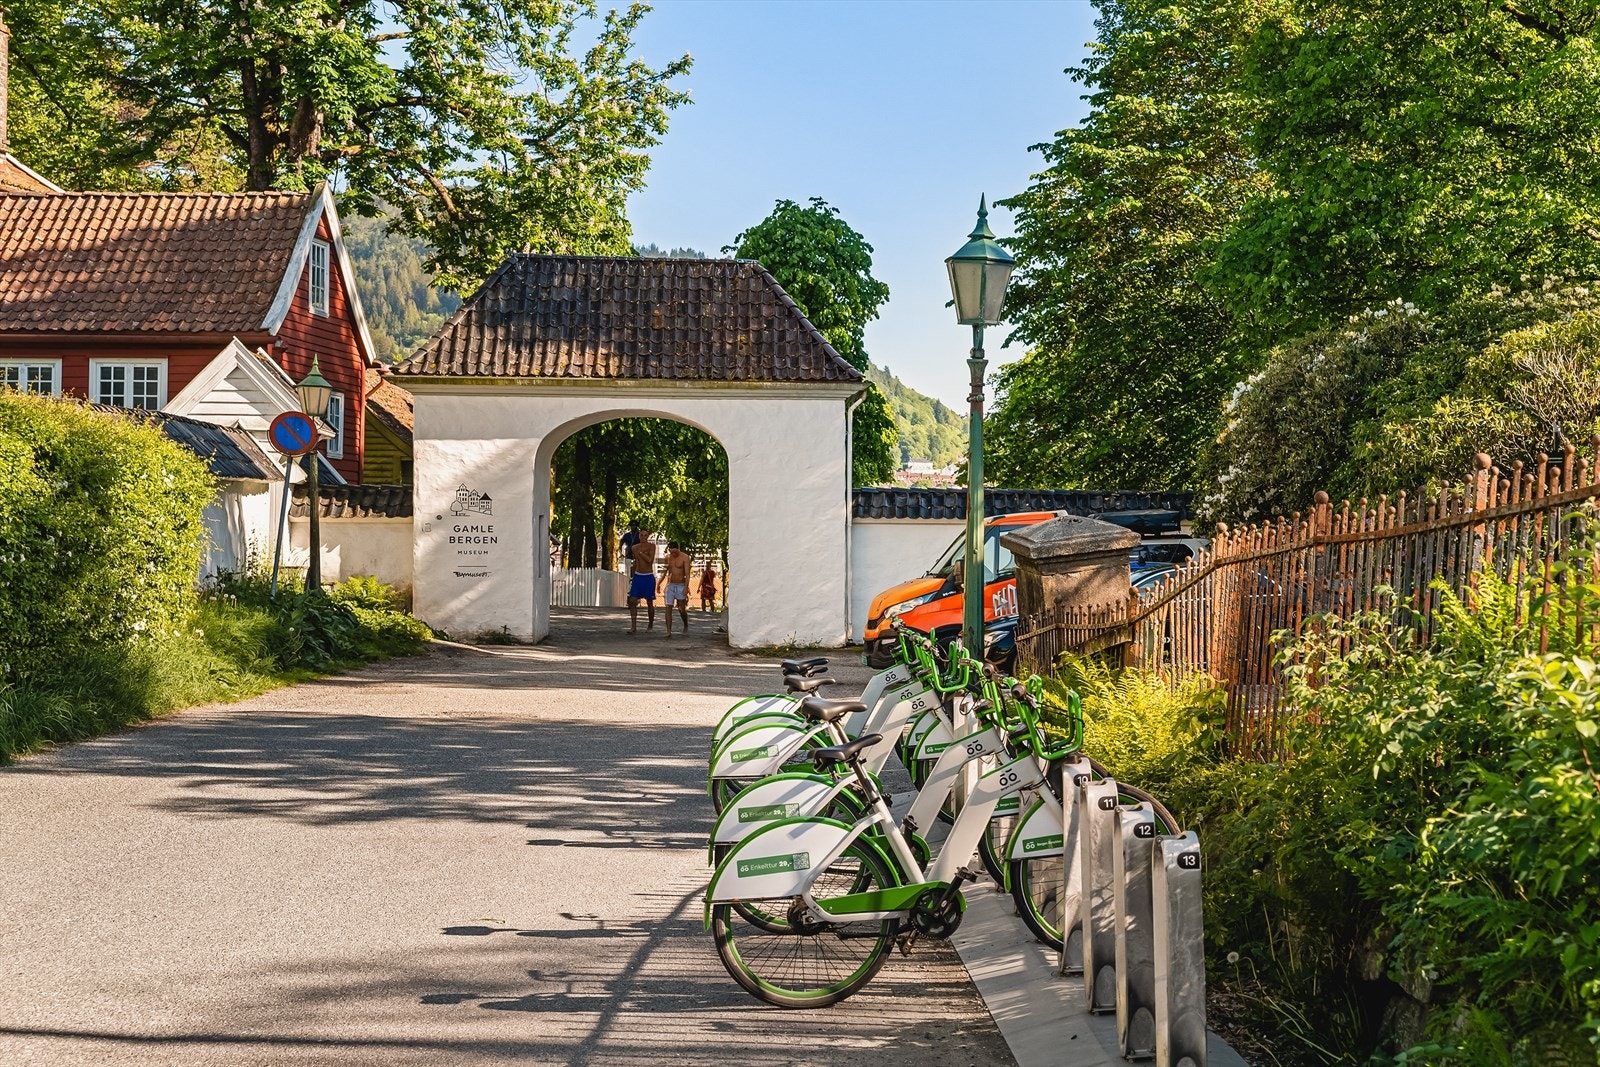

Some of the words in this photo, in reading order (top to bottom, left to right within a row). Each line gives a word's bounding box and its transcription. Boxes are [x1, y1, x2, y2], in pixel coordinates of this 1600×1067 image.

[453, 525, 494, 533] GAMLE
[449, 536, 498, 544] BERGEN
[1077, 775, 1089, 783] 10
[1103, 798, 1113, 808] 11
[1138, 825, 1151, 835] 12
[750, 861, 778, 871] Enkelttur
[778, 860, 792, 868] 29,-
[1182, 855, 1196, 866] 13
